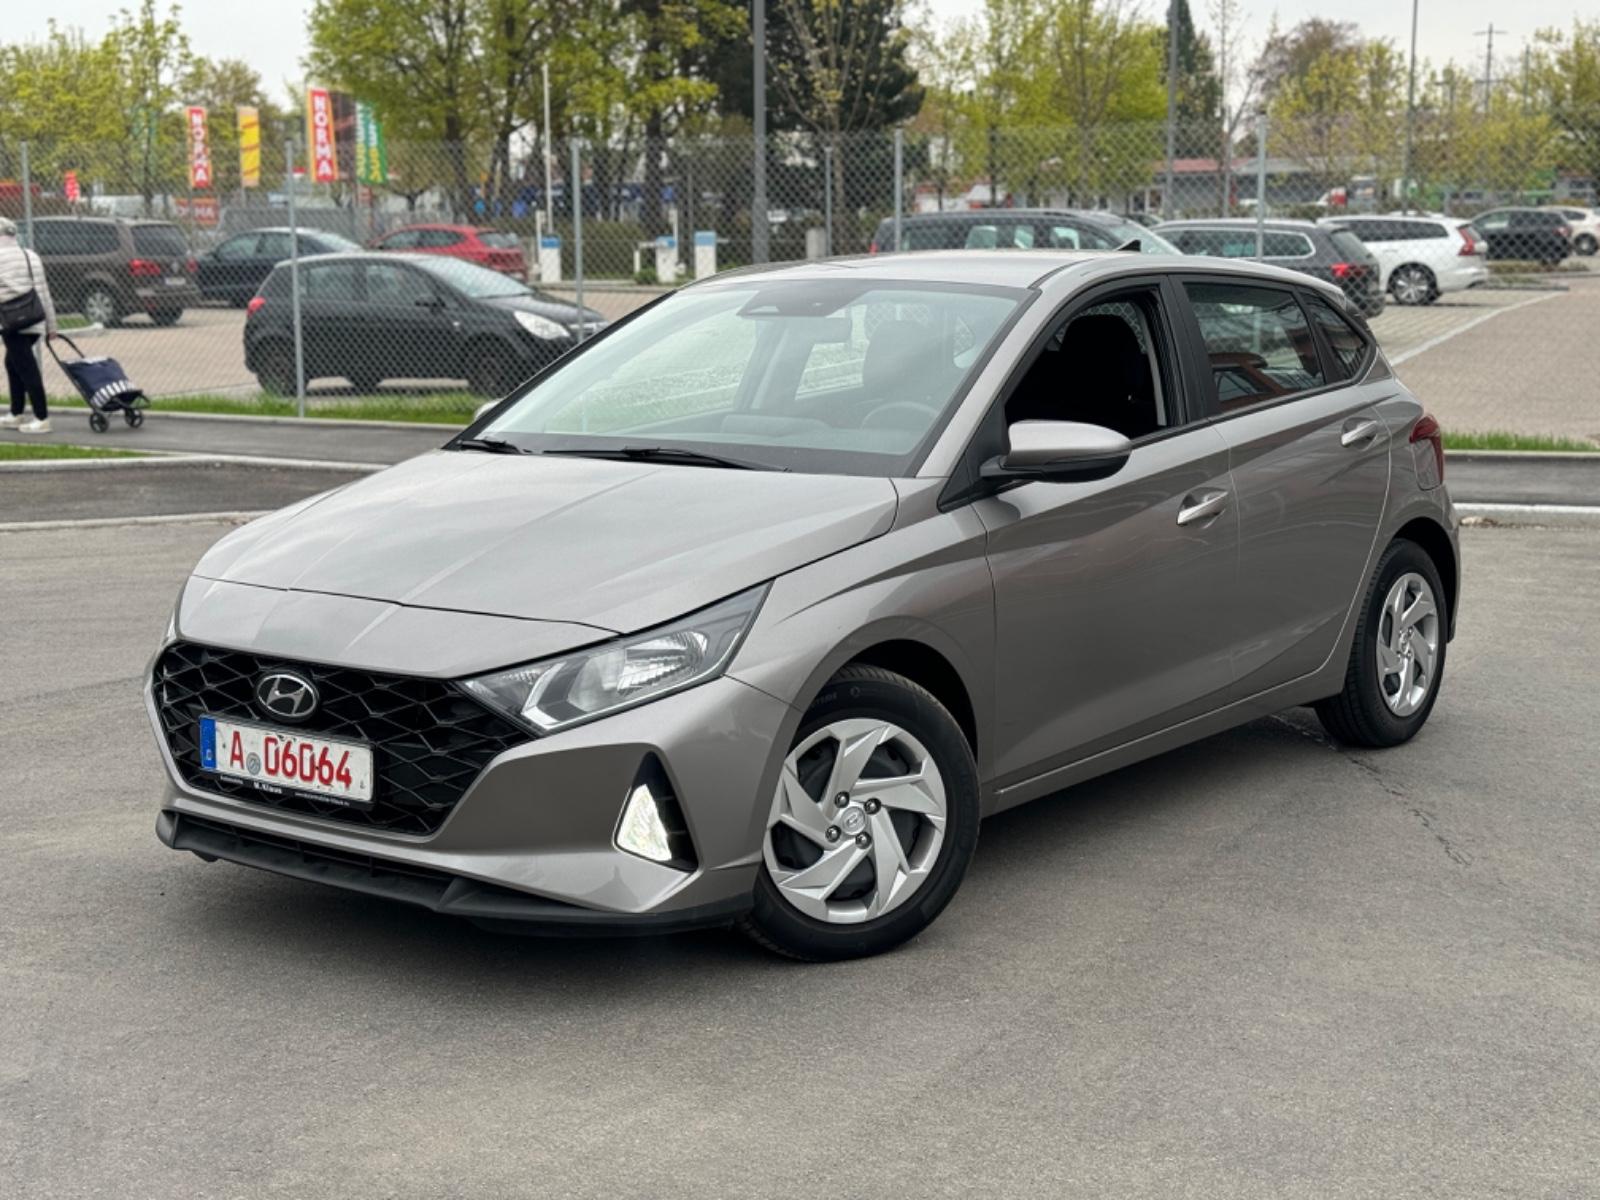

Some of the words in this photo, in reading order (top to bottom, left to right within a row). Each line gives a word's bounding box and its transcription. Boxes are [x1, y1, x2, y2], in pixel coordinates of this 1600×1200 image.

[192, 113, 207, 181] NORMA
[314, 96, 332, 175] NORMA
[230, 730, 244, 770] A
[264, 736, 352, 789] 06064
